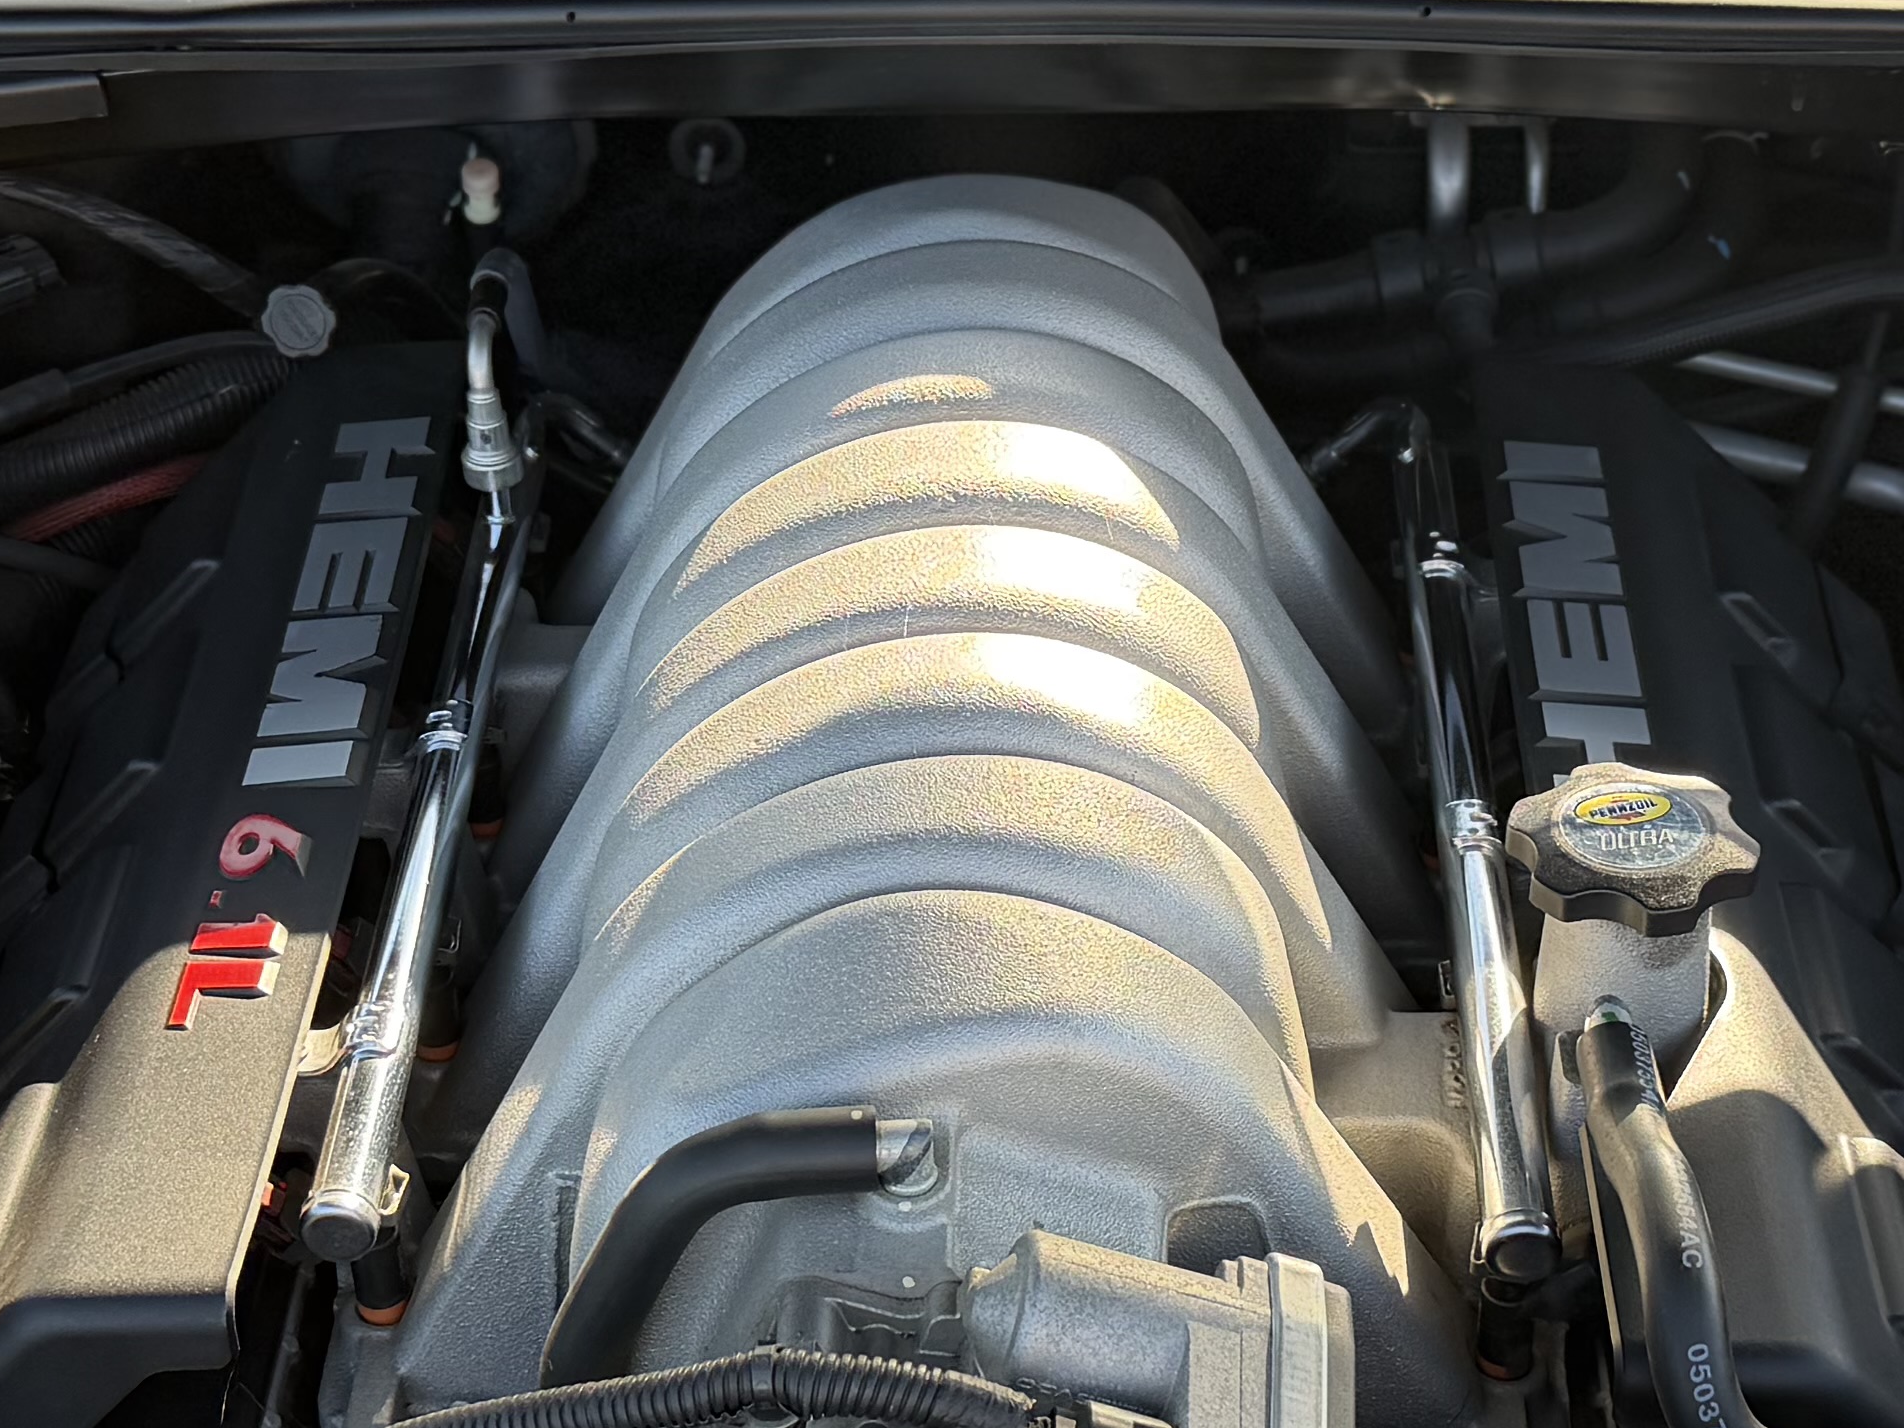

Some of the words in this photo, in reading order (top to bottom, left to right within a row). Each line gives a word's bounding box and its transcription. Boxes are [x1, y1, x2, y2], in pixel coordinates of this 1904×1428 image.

[242, 416, 436, 786] HEMI
[1588, 798, 1658, 820] PENNZOIL
[1598, 828, 1675, 852] ULTRA
[166, 812, 312, 1031] 6.1L
